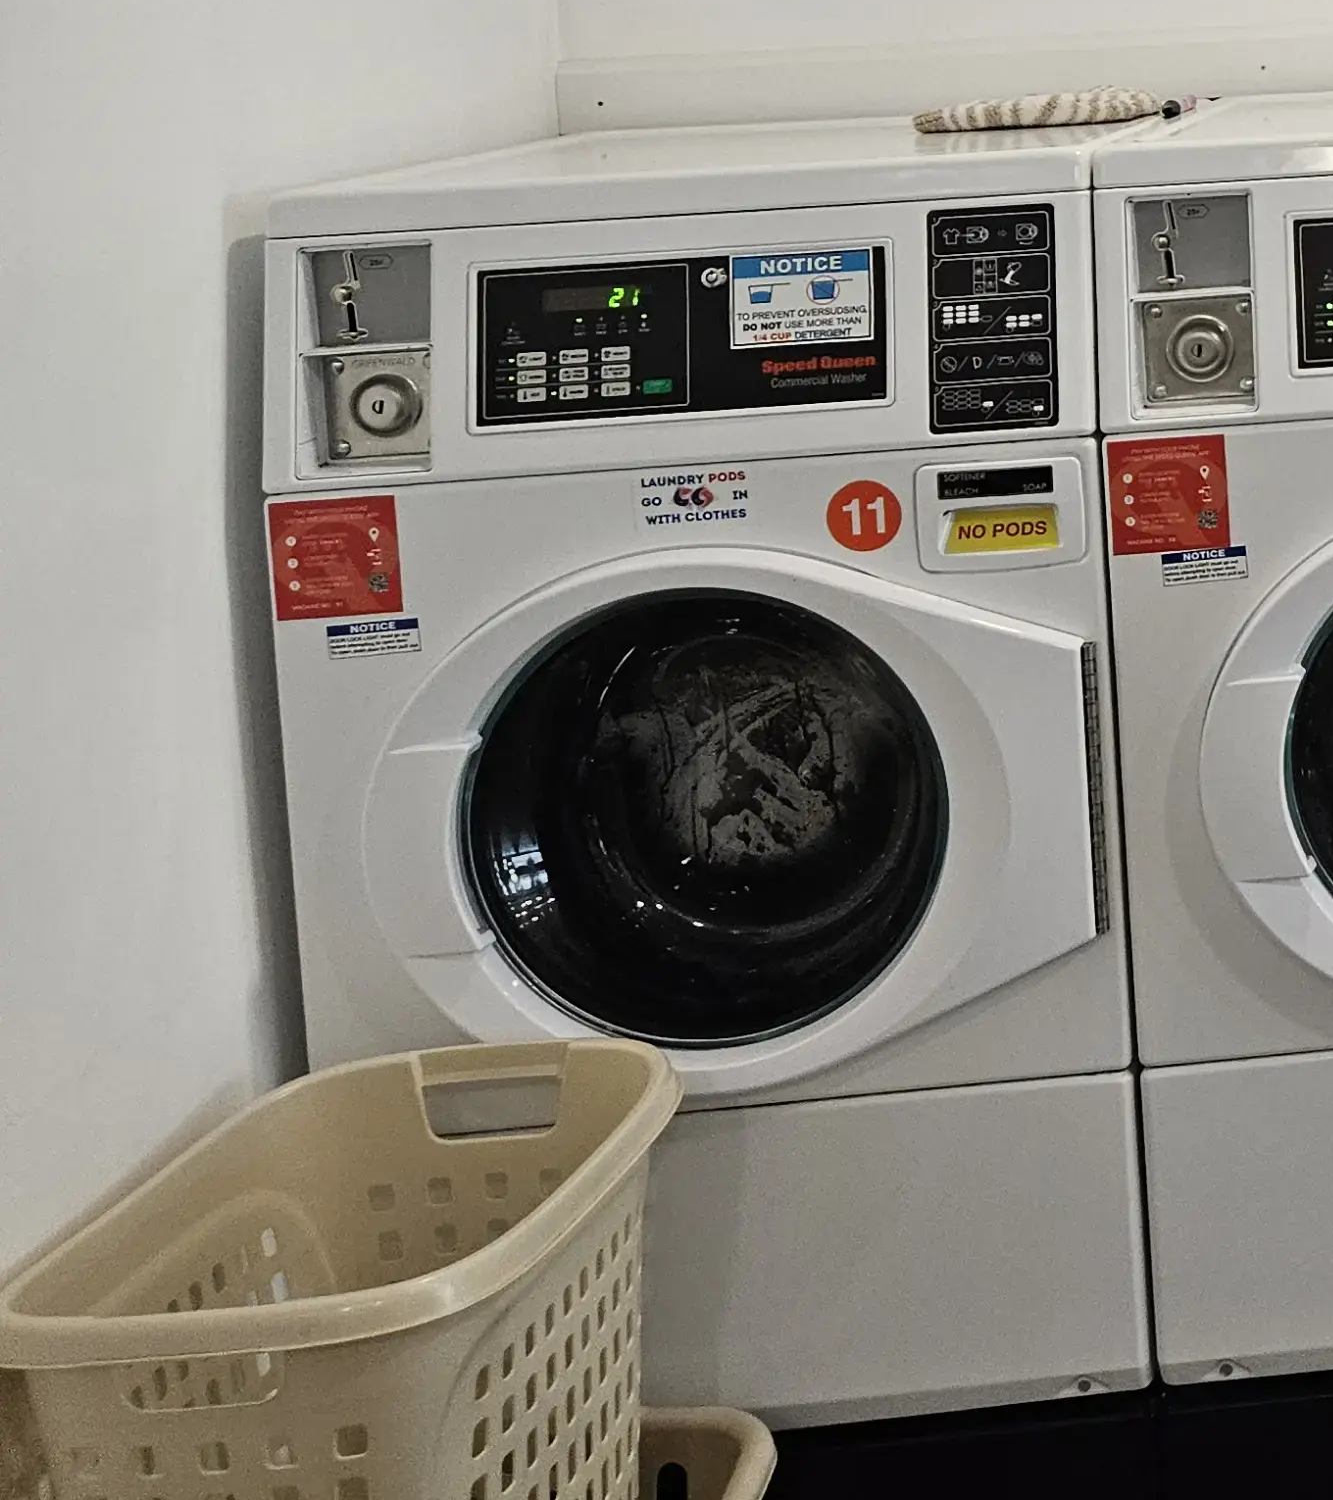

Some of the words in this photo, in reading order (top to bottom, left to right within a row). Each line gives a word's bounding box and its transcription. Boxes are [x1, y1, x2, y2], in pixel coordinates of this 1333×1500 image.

[761, 256, 842, 274] NOTICE
[608, 288, 640, 308] 21
[737, 313, 750, 321] TO
[752, 310, 795, 319] PREVENT
[743, 323, 757, 331] DO
[761, 322, 782, 330] NOT
[784, 320, 805, 329] USE
[806, 318, 833, 327] MORE
[836, 317, 861, 325] THAN
[770, 332, 791, 340] CUP
[795, 328, 852, 339] DETERGENT
[762, 357, 817, 374] Speed
[821, 356, 876, 369] Queen
[771, 376, 828, 388] Commercial
[831, 373, 867, 383] Washer
[641, 474, 704, 488] LAUNDRY
[709, 471, 745, 482] PODS
[1023, 483, 1047, 491] SOAP
[641, 497, 662, 506] GO
[732, 490, 748, 500] IN
[645, 514, 681, 525] WITH
[685, 509, 747, 522] CLOTHES
[841, 496, 887, 536] 11
[958, 525, 986, 539] NO
[992, 521, 1047, 537] PODS
[1183, 549, 1225, 561] NOTICE
[350, 621, 396, 633] NOTICE
